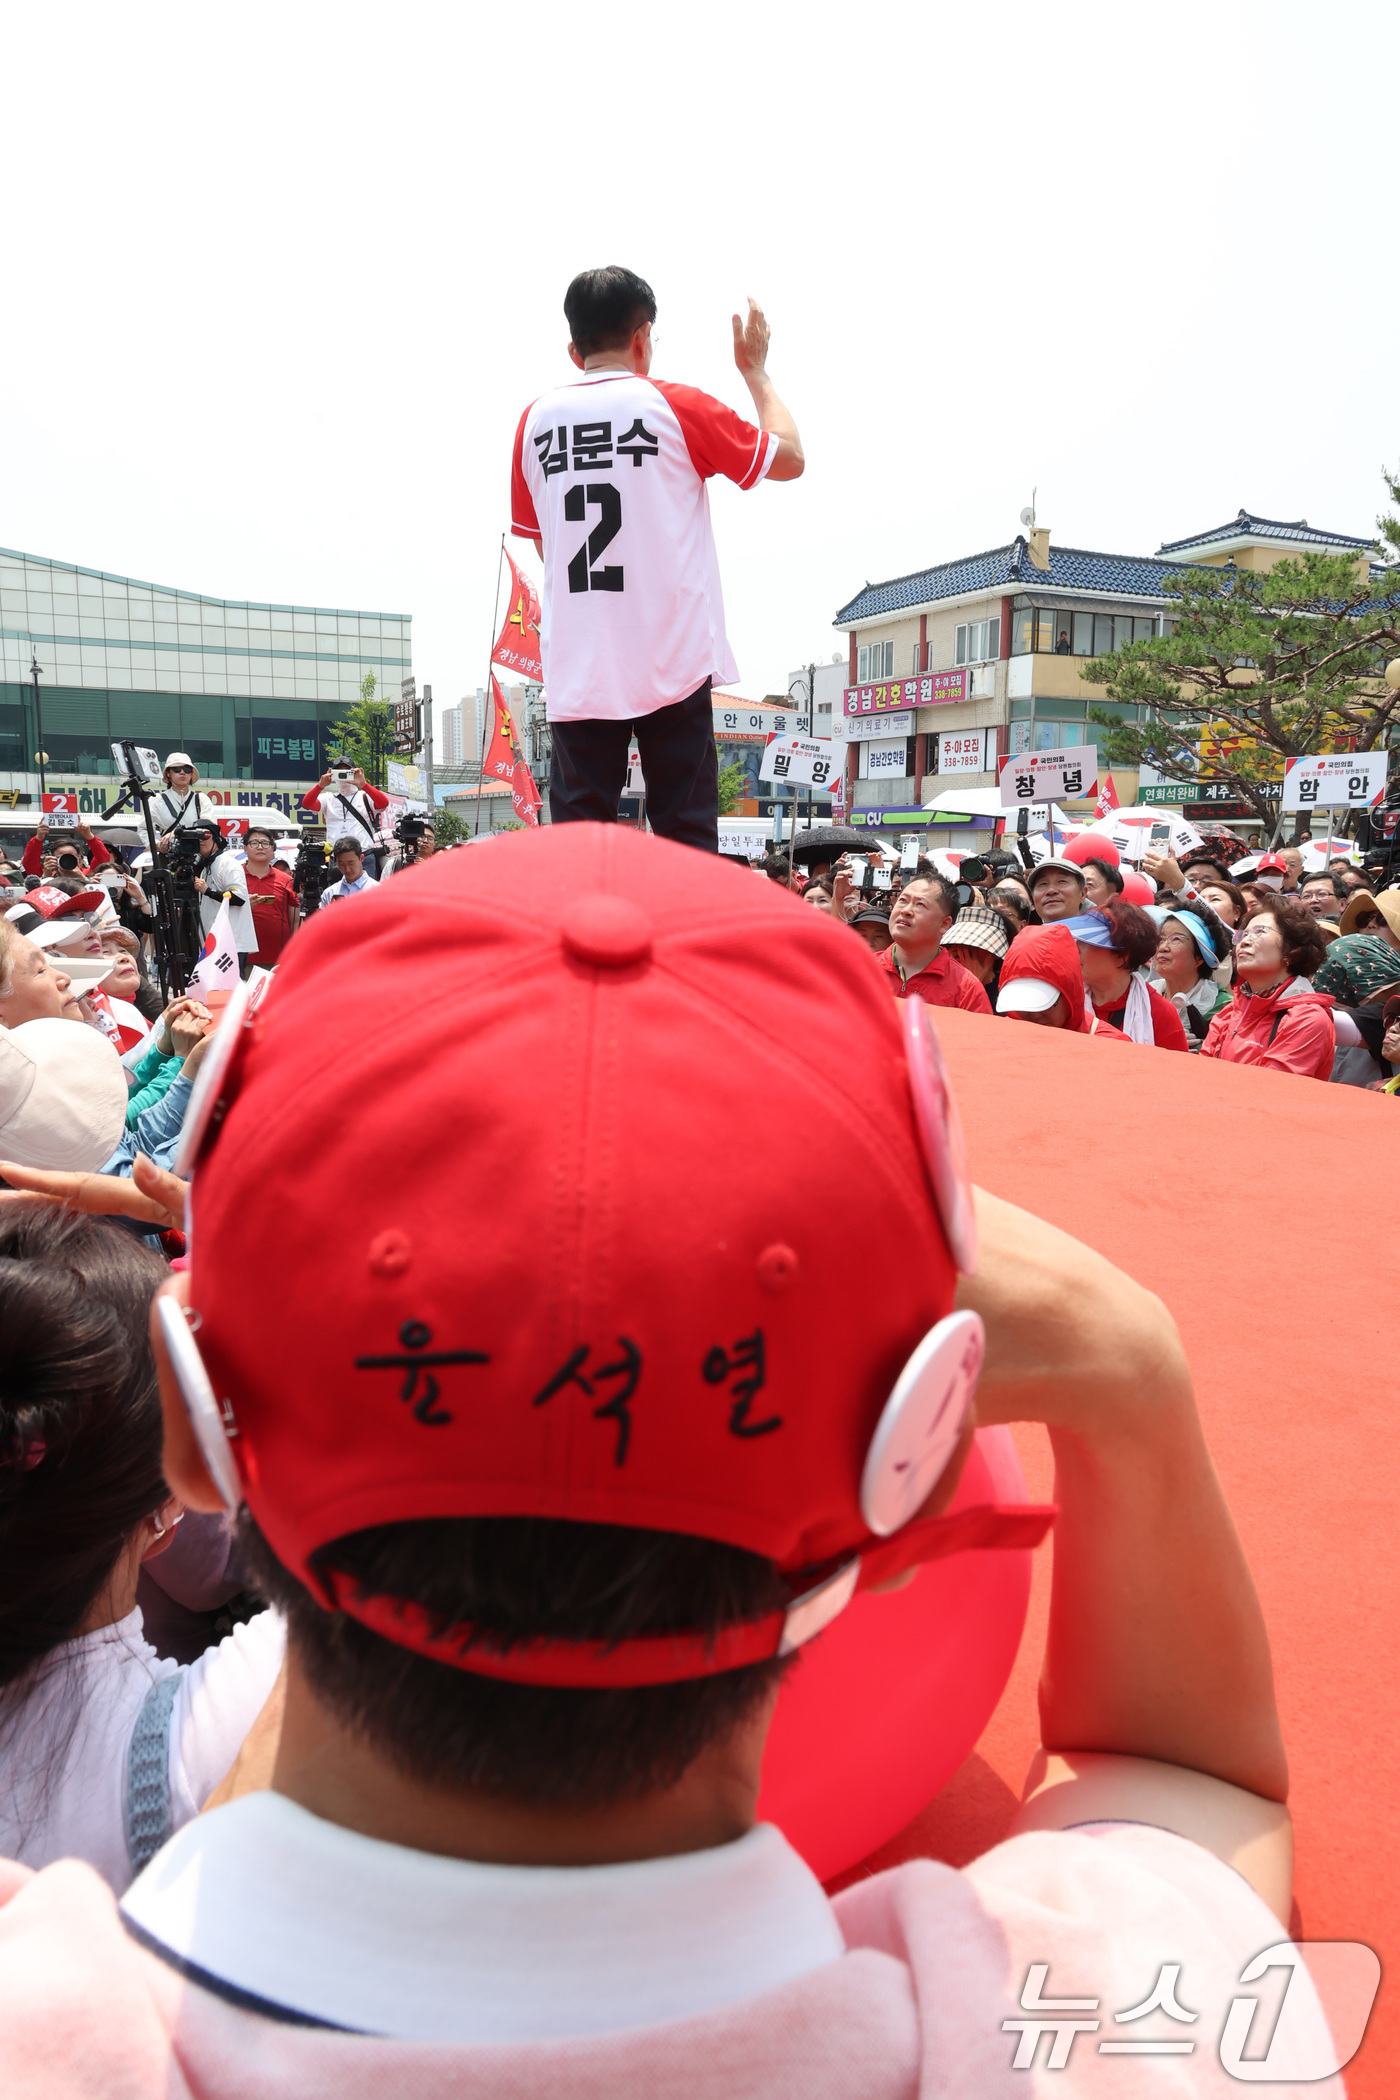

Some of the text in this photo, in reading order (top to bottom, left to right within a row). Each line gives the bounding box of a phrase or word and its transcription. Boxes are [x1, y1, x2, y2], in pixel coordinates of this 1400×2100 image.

[534, 419, 659, 483] 김문수
[564, 483, 624, 593] 2
[950, 674, 962, 686] 모집
[847, 679, 933, 713] 경남간호학원
[934, 687, 962, 700] 338-7859
[848, 717, 891, 734] 신기의료기
[257, 737, 315, 761] 파크볼링
[963, 738, 979, 753] 모집
[870, 750, 905, 768] 경남간호학원
[944, 755, 978, 767] 338-7859
[1040, 756, 1065, 764] 국민의힘
[1328, 760, 1353, 768] 국민의힘
[773, 754, 831, 784] 밀양
[1015, 769, 1082, 798] 창녕
[1299, 776, 1369, 802] 함안
[1145, 785, 1199, 802] 연회석완비
[51, 795, 69, 813] 2
[866, 811, 882, 826] CU
[226, 820, 241, 837] 2
